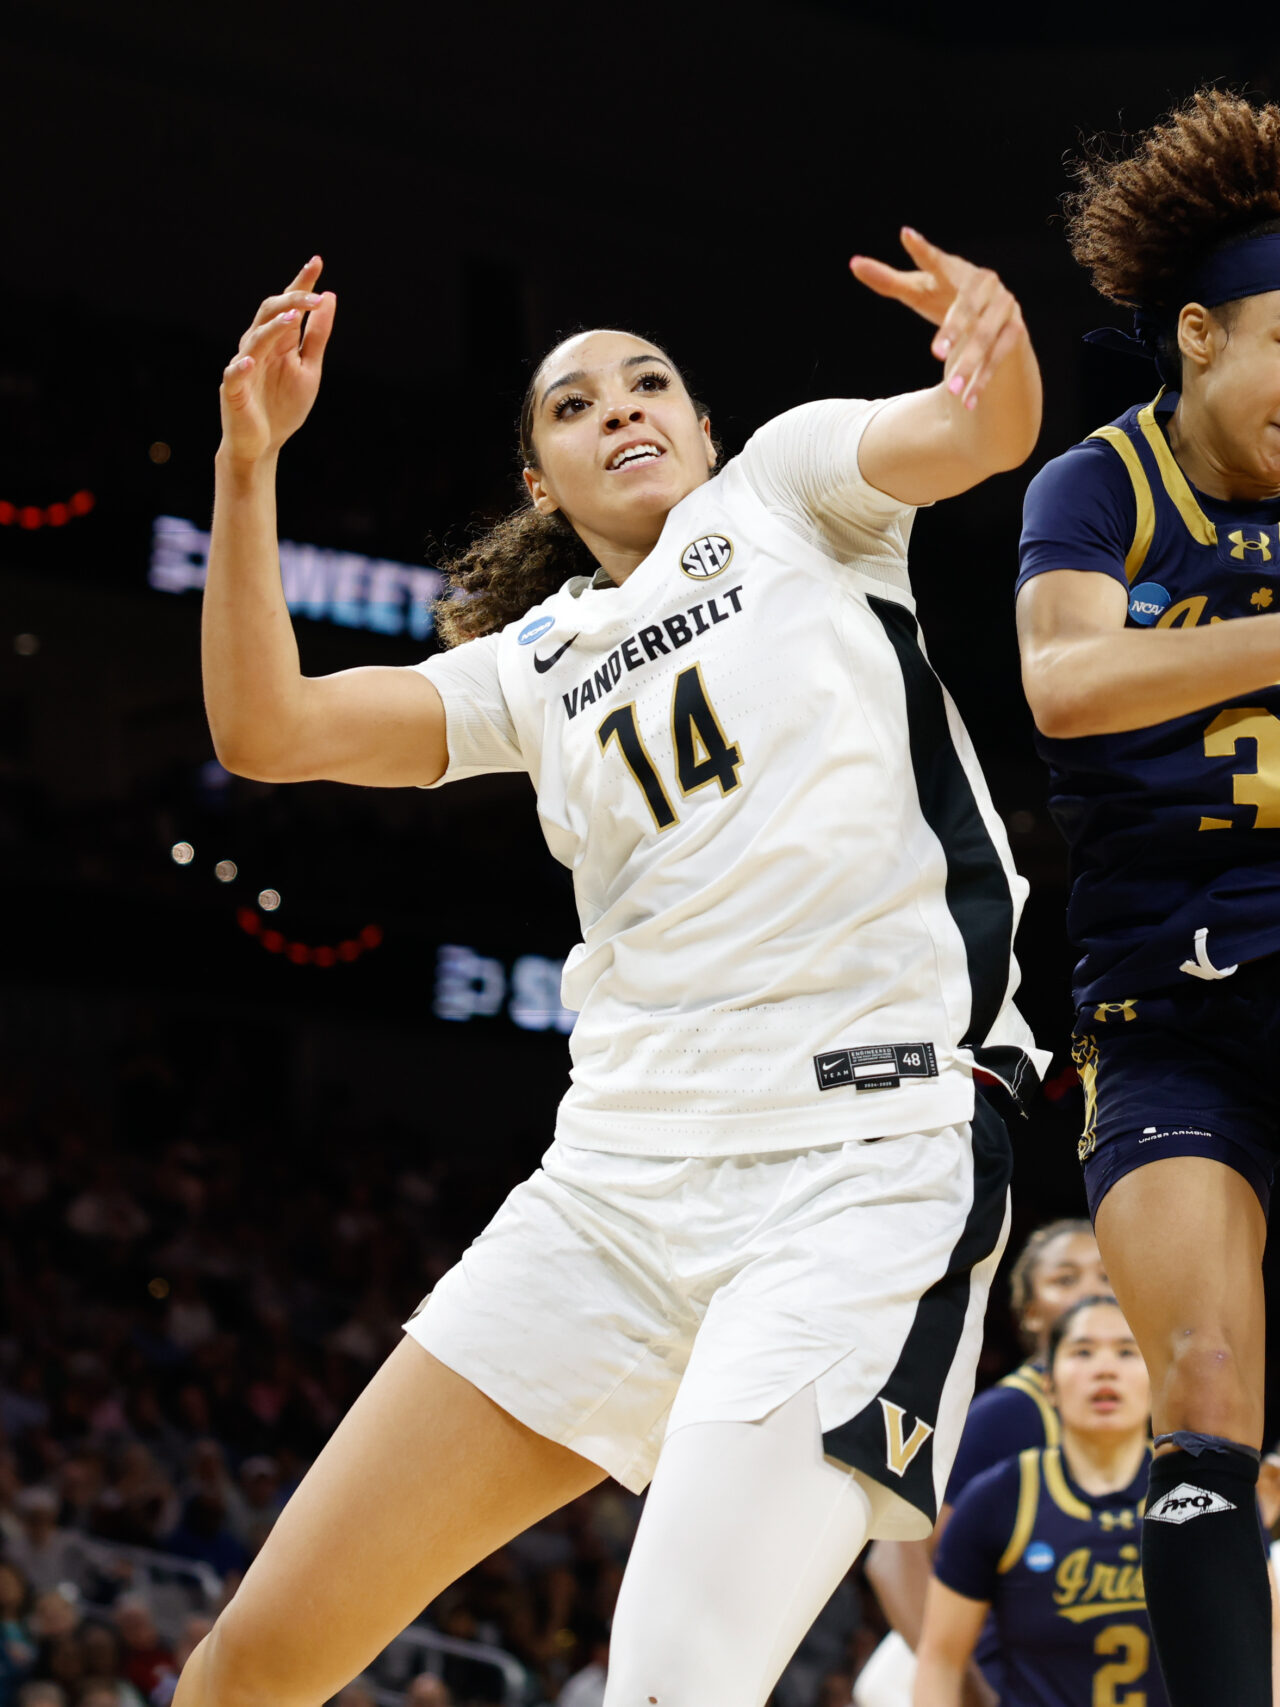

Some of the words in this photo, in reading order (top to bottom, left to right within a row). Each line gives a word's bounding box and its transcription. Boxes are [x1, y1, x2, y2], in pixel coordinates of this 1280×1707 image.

[681, 536, 731, 577] SEC
[562, 585, 743, 721] VANDERBILT
[595, 660, 745, 833] 14
[824, 1070, 849, 1080] TEAM
[902, 1052, 921, 1067] 48
[1138, 1132, 1170, 1144] UNDER
[1171, 1130, 1213, 1138] ARMOUR
[877, 1396, 934, 1478] V
[1160, 1493, 1213, 1515] PRO
[1092, 1623, 1150, 1707] 2
